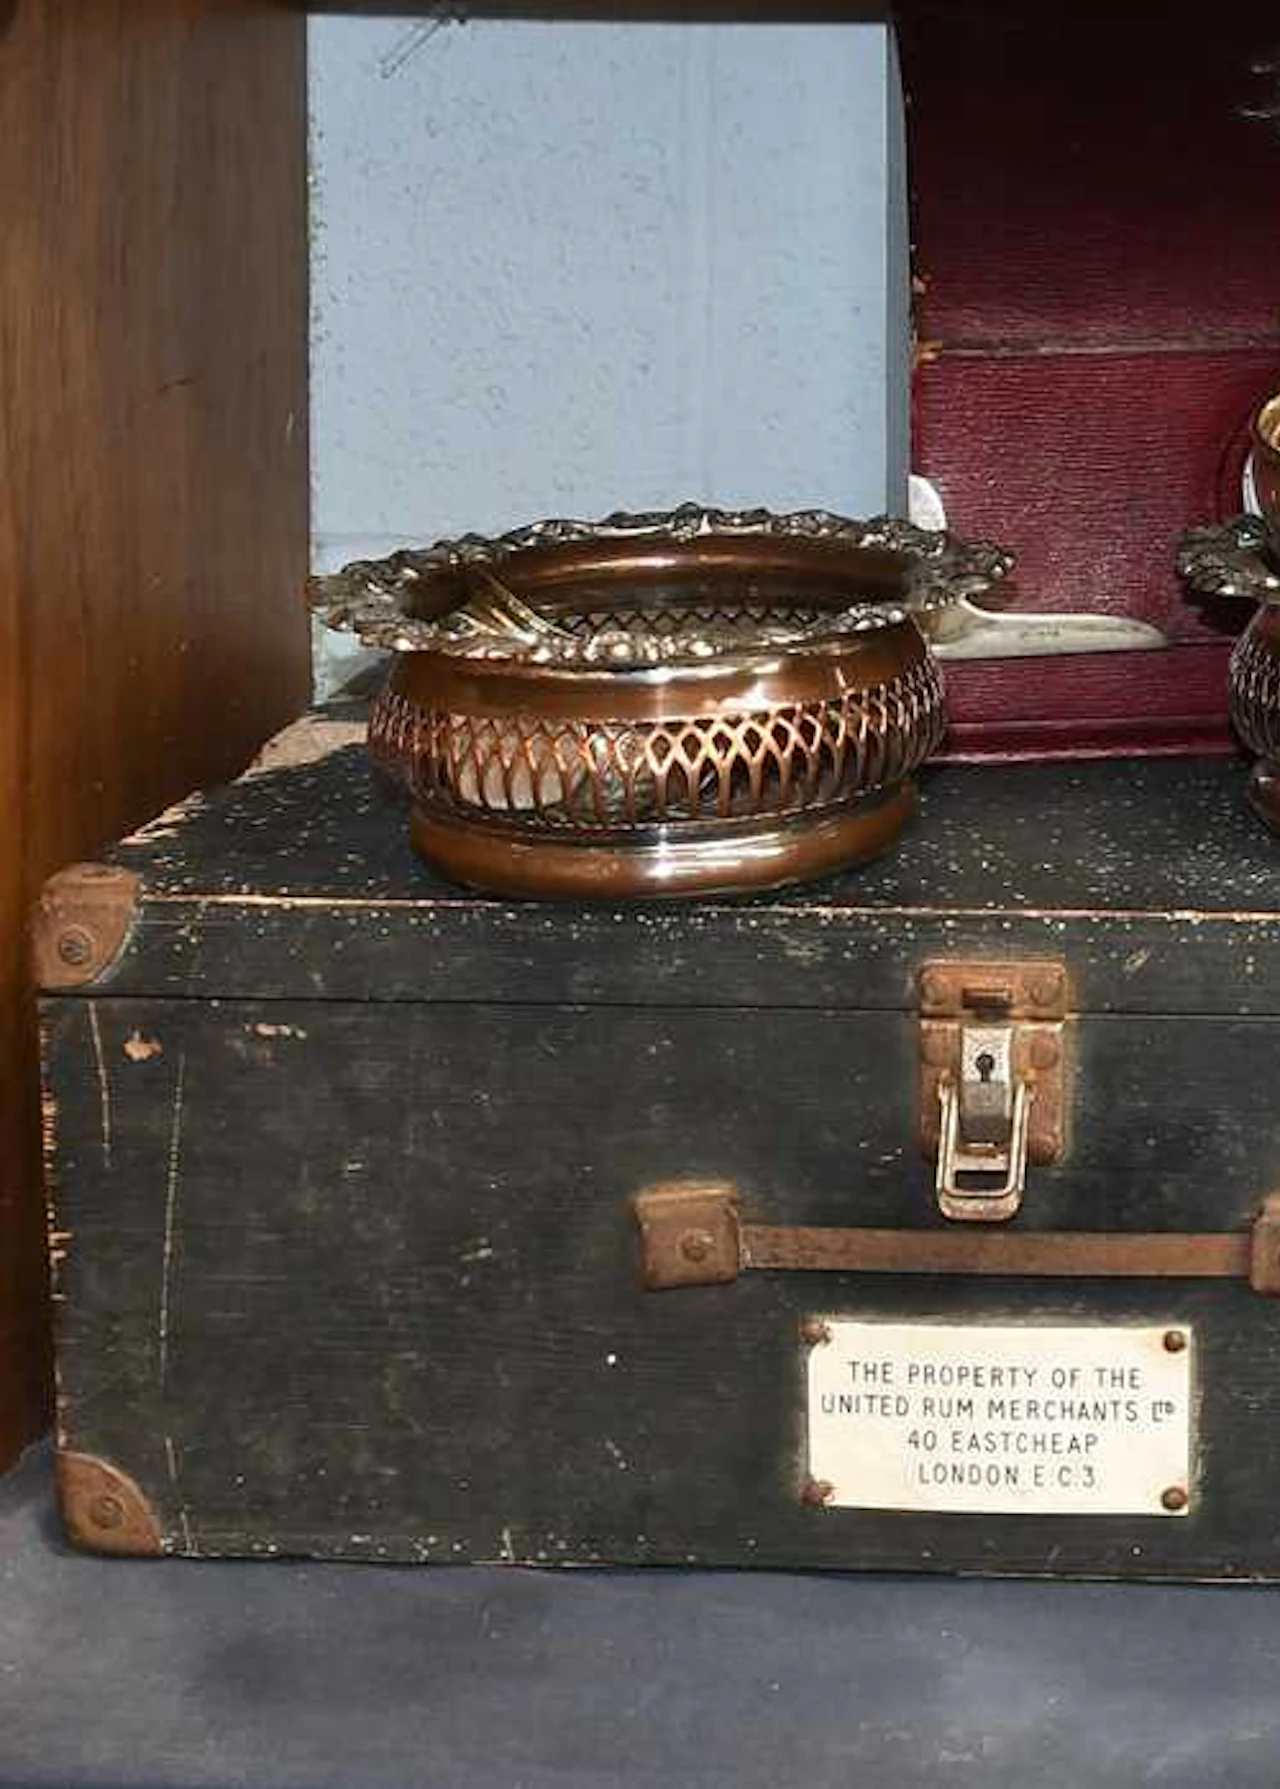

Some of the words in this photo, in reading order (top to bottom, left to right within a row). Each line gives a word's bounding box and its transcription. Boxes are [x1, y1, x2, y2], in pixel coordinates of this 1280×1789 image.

[848, 1361, 893, 1384] THE
[908, 1364, 1037, 1388] PROPERTY
[1051, 1368, 1082, 1389] OF
[1095, 1368, 1141, 1390] THE
[821, 1394, 909, 1416] UNITED
[923, 1397, 973, 1418] RUM
[988, 1399, 1138, 1422] MERCHANTS
[908, 1430, 937, 1451] 40
[951, 1431, 1099, 1454] EASTCHEAP
[918, 1462, 1019, 1486] LONDON
